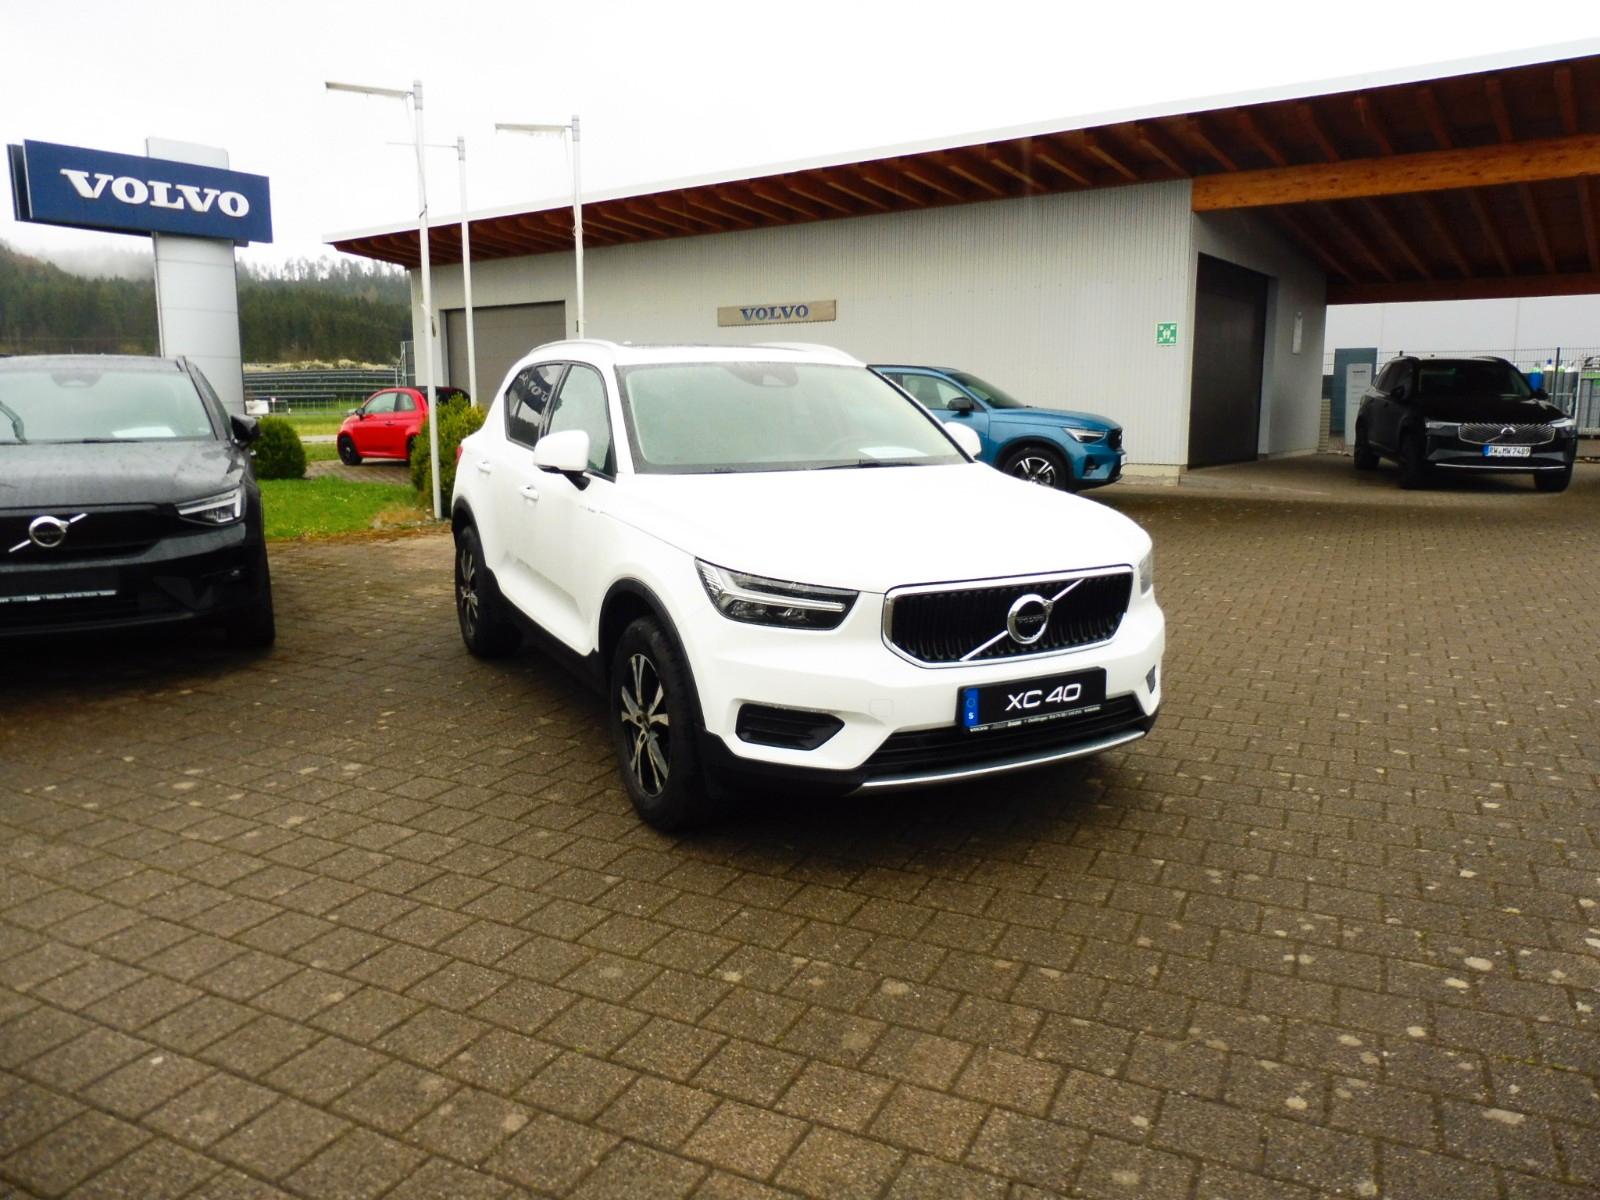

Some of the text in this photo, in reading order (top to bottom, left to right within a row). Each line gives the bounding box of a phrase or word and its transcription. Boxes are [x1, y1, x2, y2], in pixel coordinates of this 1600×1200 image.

[60, 168, 250, 218] VOLVO
[740, 304, 809, 321] VOLVO
[1005, 683, 1082, 711] XC 40
